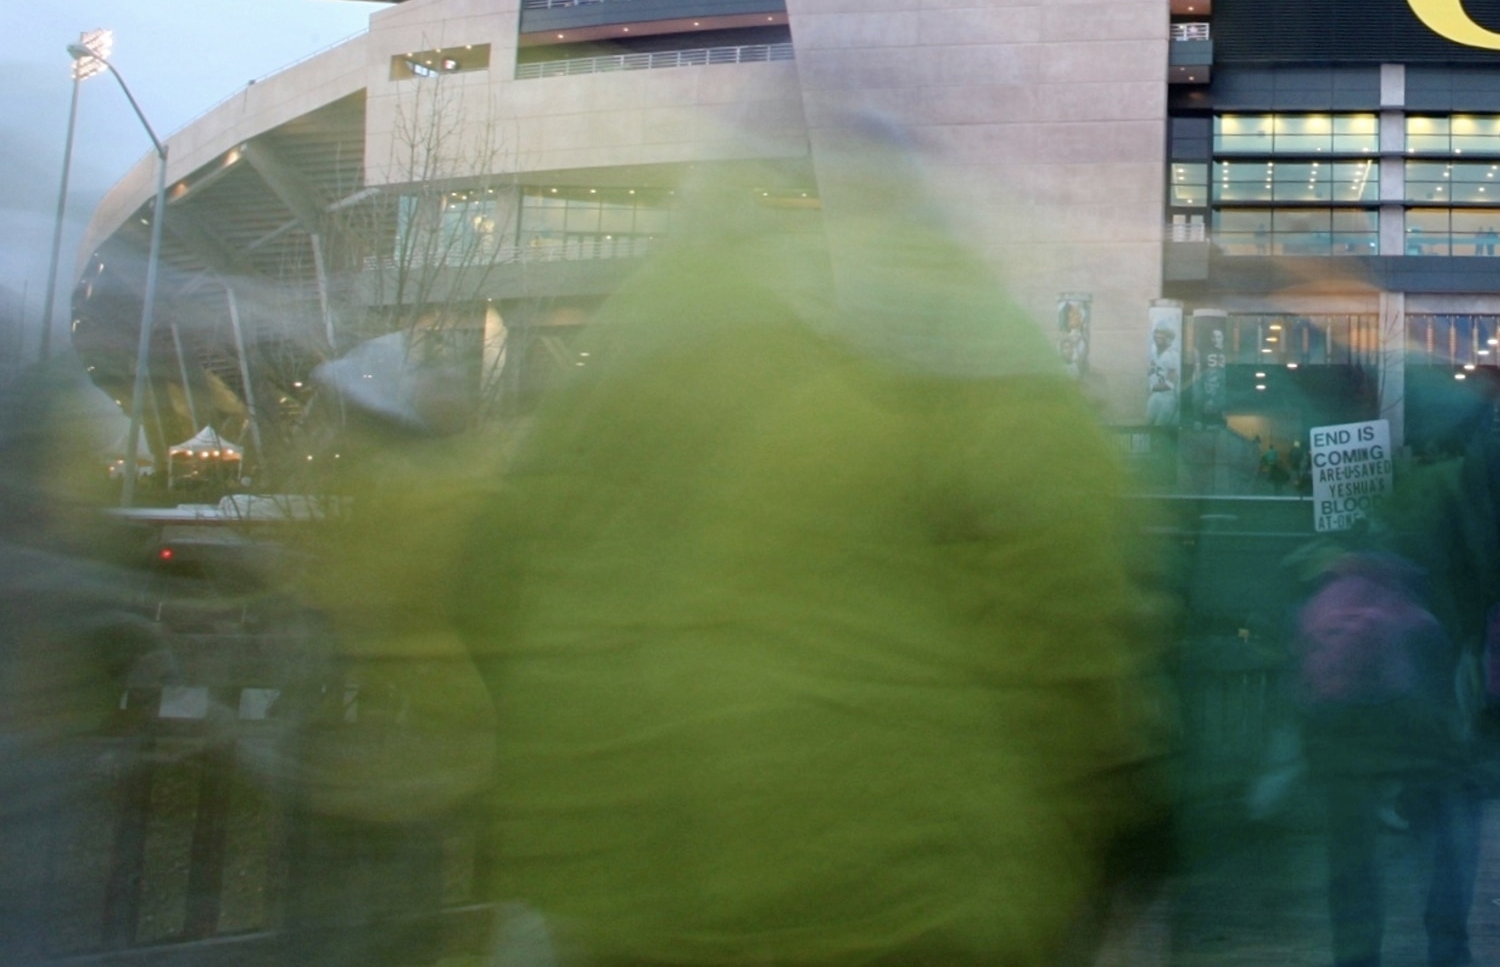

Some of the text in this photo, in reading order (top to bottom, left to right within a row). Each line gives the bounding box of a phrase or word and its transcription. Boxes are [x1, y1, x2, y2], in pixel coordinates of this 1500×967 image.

[1313, 425, 1375, 447] END IS
[1313, 444, 1384, 468] COMING
[1329, 478, 1385, 498] YESHUA'S
